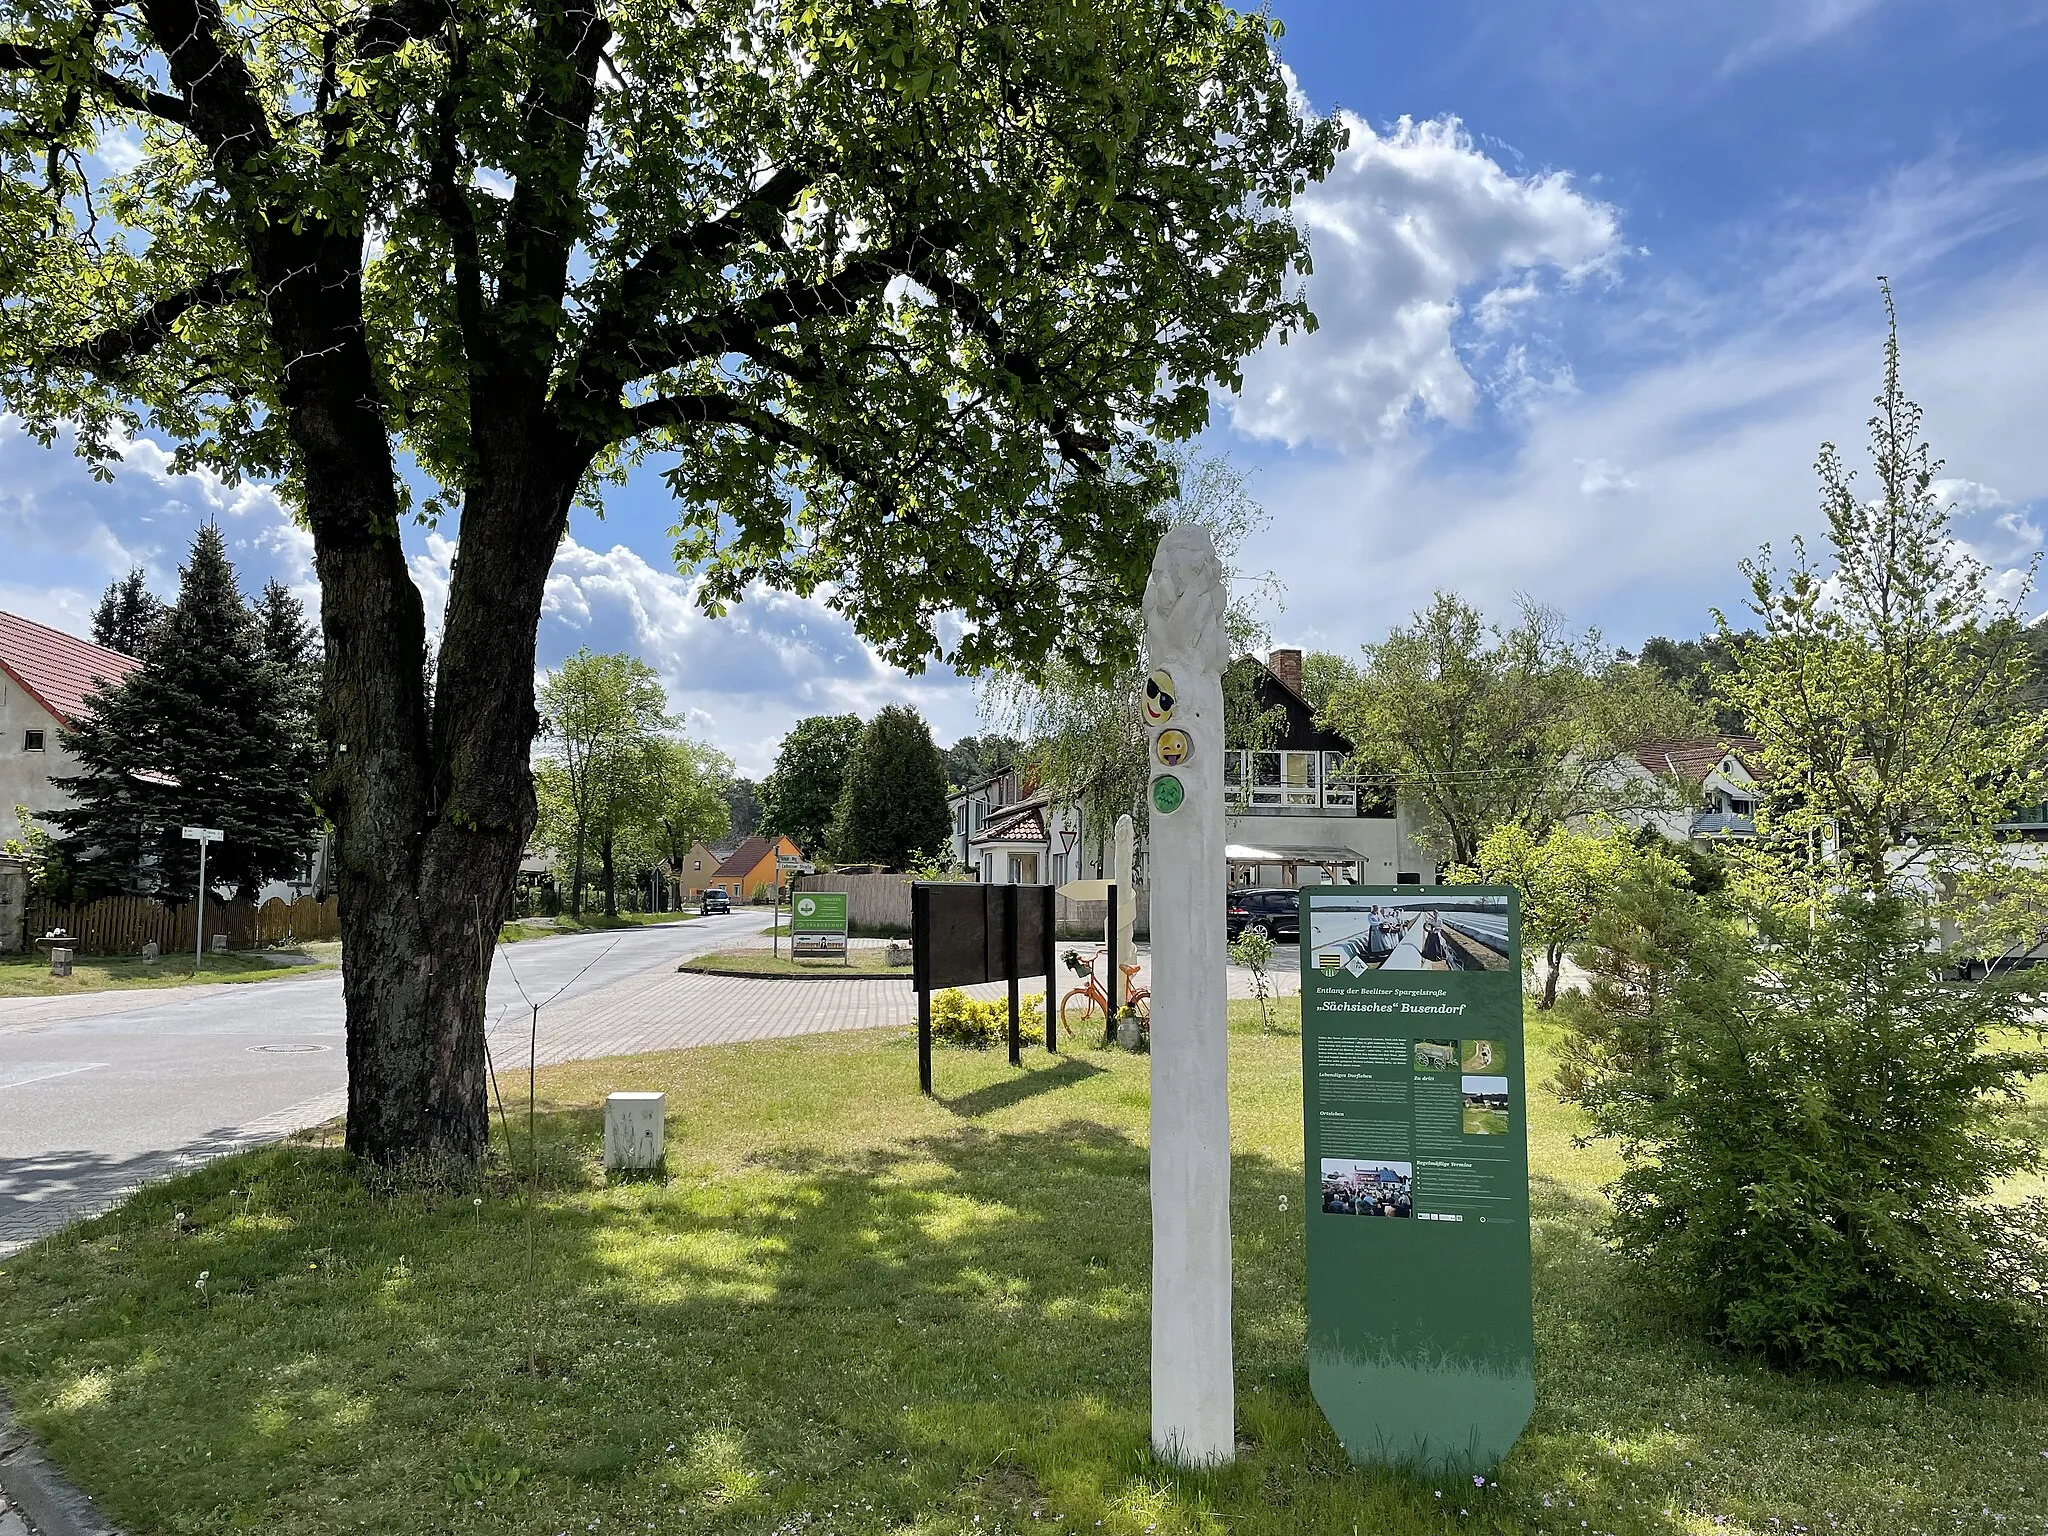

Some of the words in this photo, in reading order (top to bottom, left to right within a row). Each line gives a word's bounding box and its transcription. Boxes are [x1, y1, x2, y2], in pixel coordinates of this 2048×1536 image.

[1316, 987, 1345, 995] Entlang
[1394, 988, 1447, 997] Spargelstraße
[1316, 1001, 1399, 1013] „Sächsisches“
[1400, 1003, 1466, 1016] Busendorf
[1416, 1160, 1450, 1168] Regelmäßige
